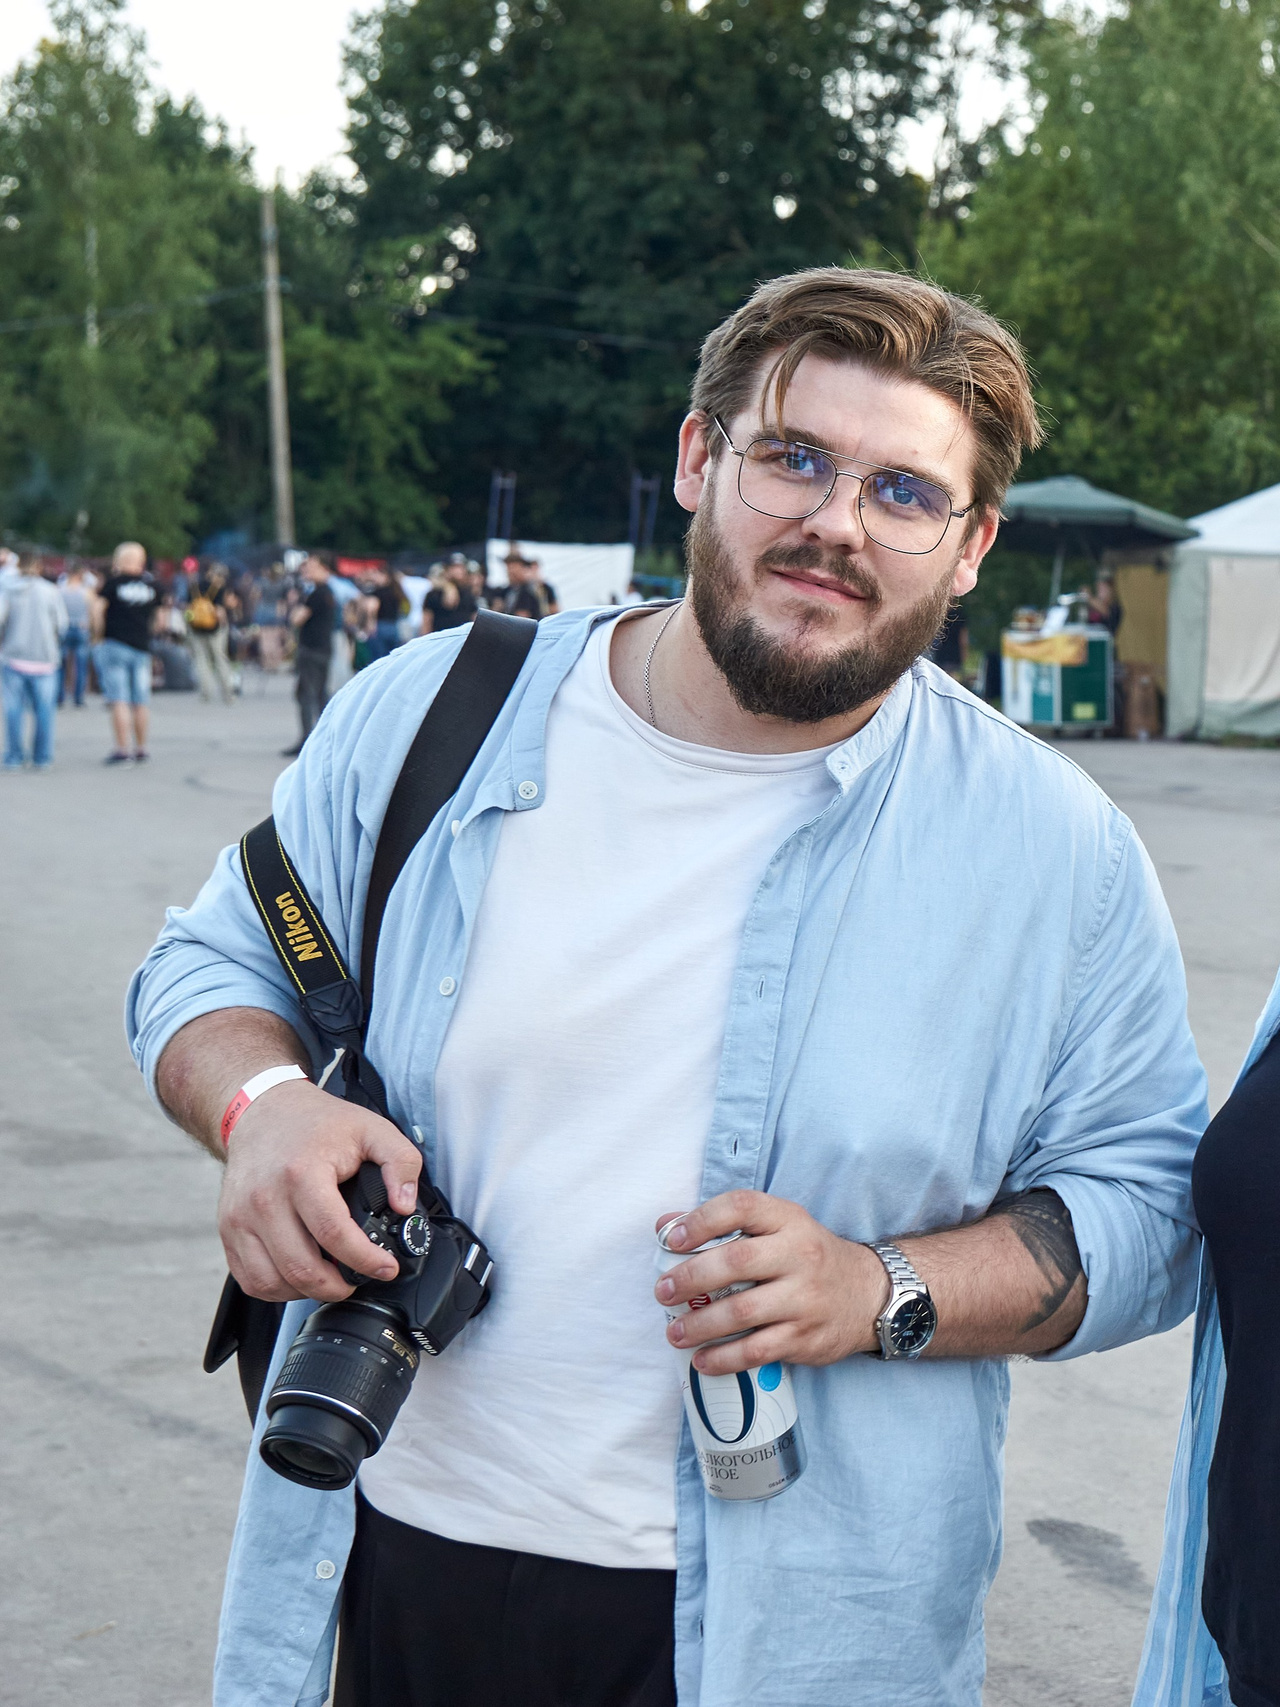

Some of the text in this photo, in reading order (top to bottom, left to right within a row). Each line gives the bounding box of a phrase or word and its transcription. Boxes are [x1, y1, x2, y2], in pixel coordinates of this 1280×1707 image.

[275, 891, 324, 963] Nikon
[411, 1330, 438, 1355] Nikon
[697, 1431, 797, 1468] АЛКОГОЛЬНОЕ
[701, 1464, 740, 1480] ТЛОЕ
